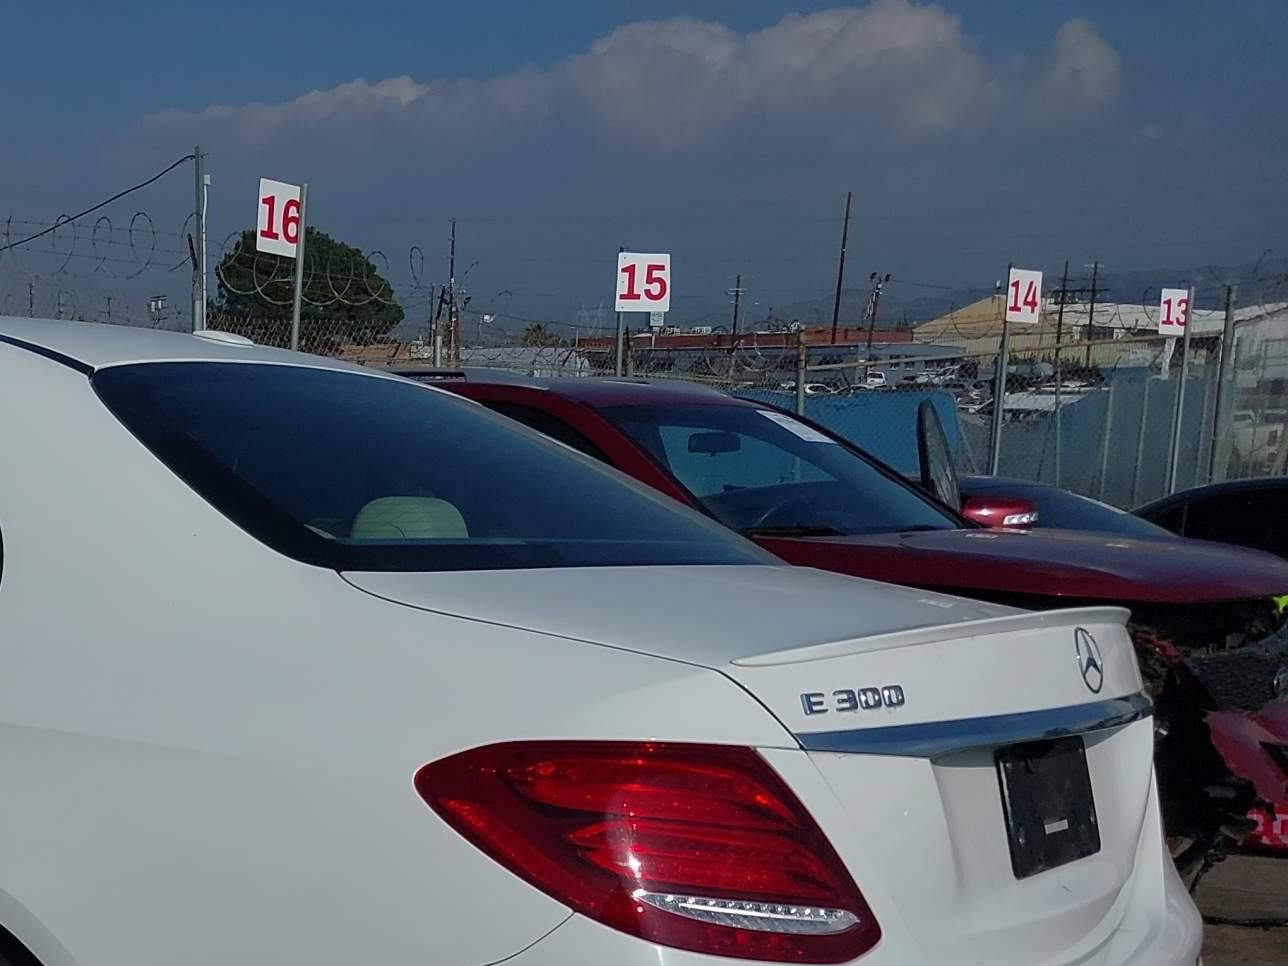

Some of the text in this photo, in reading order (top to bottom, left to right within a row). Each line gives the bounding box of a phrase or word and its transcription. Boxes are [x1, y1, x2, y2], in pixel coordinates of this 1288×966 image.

[259, 195, 300, 244] 16
[620, 263, 668, 301] 15
[1008, 281, 1039, 313] 14
[1161, 299, 1188, 326] 13
[800, 685, 905, 716] E 300
